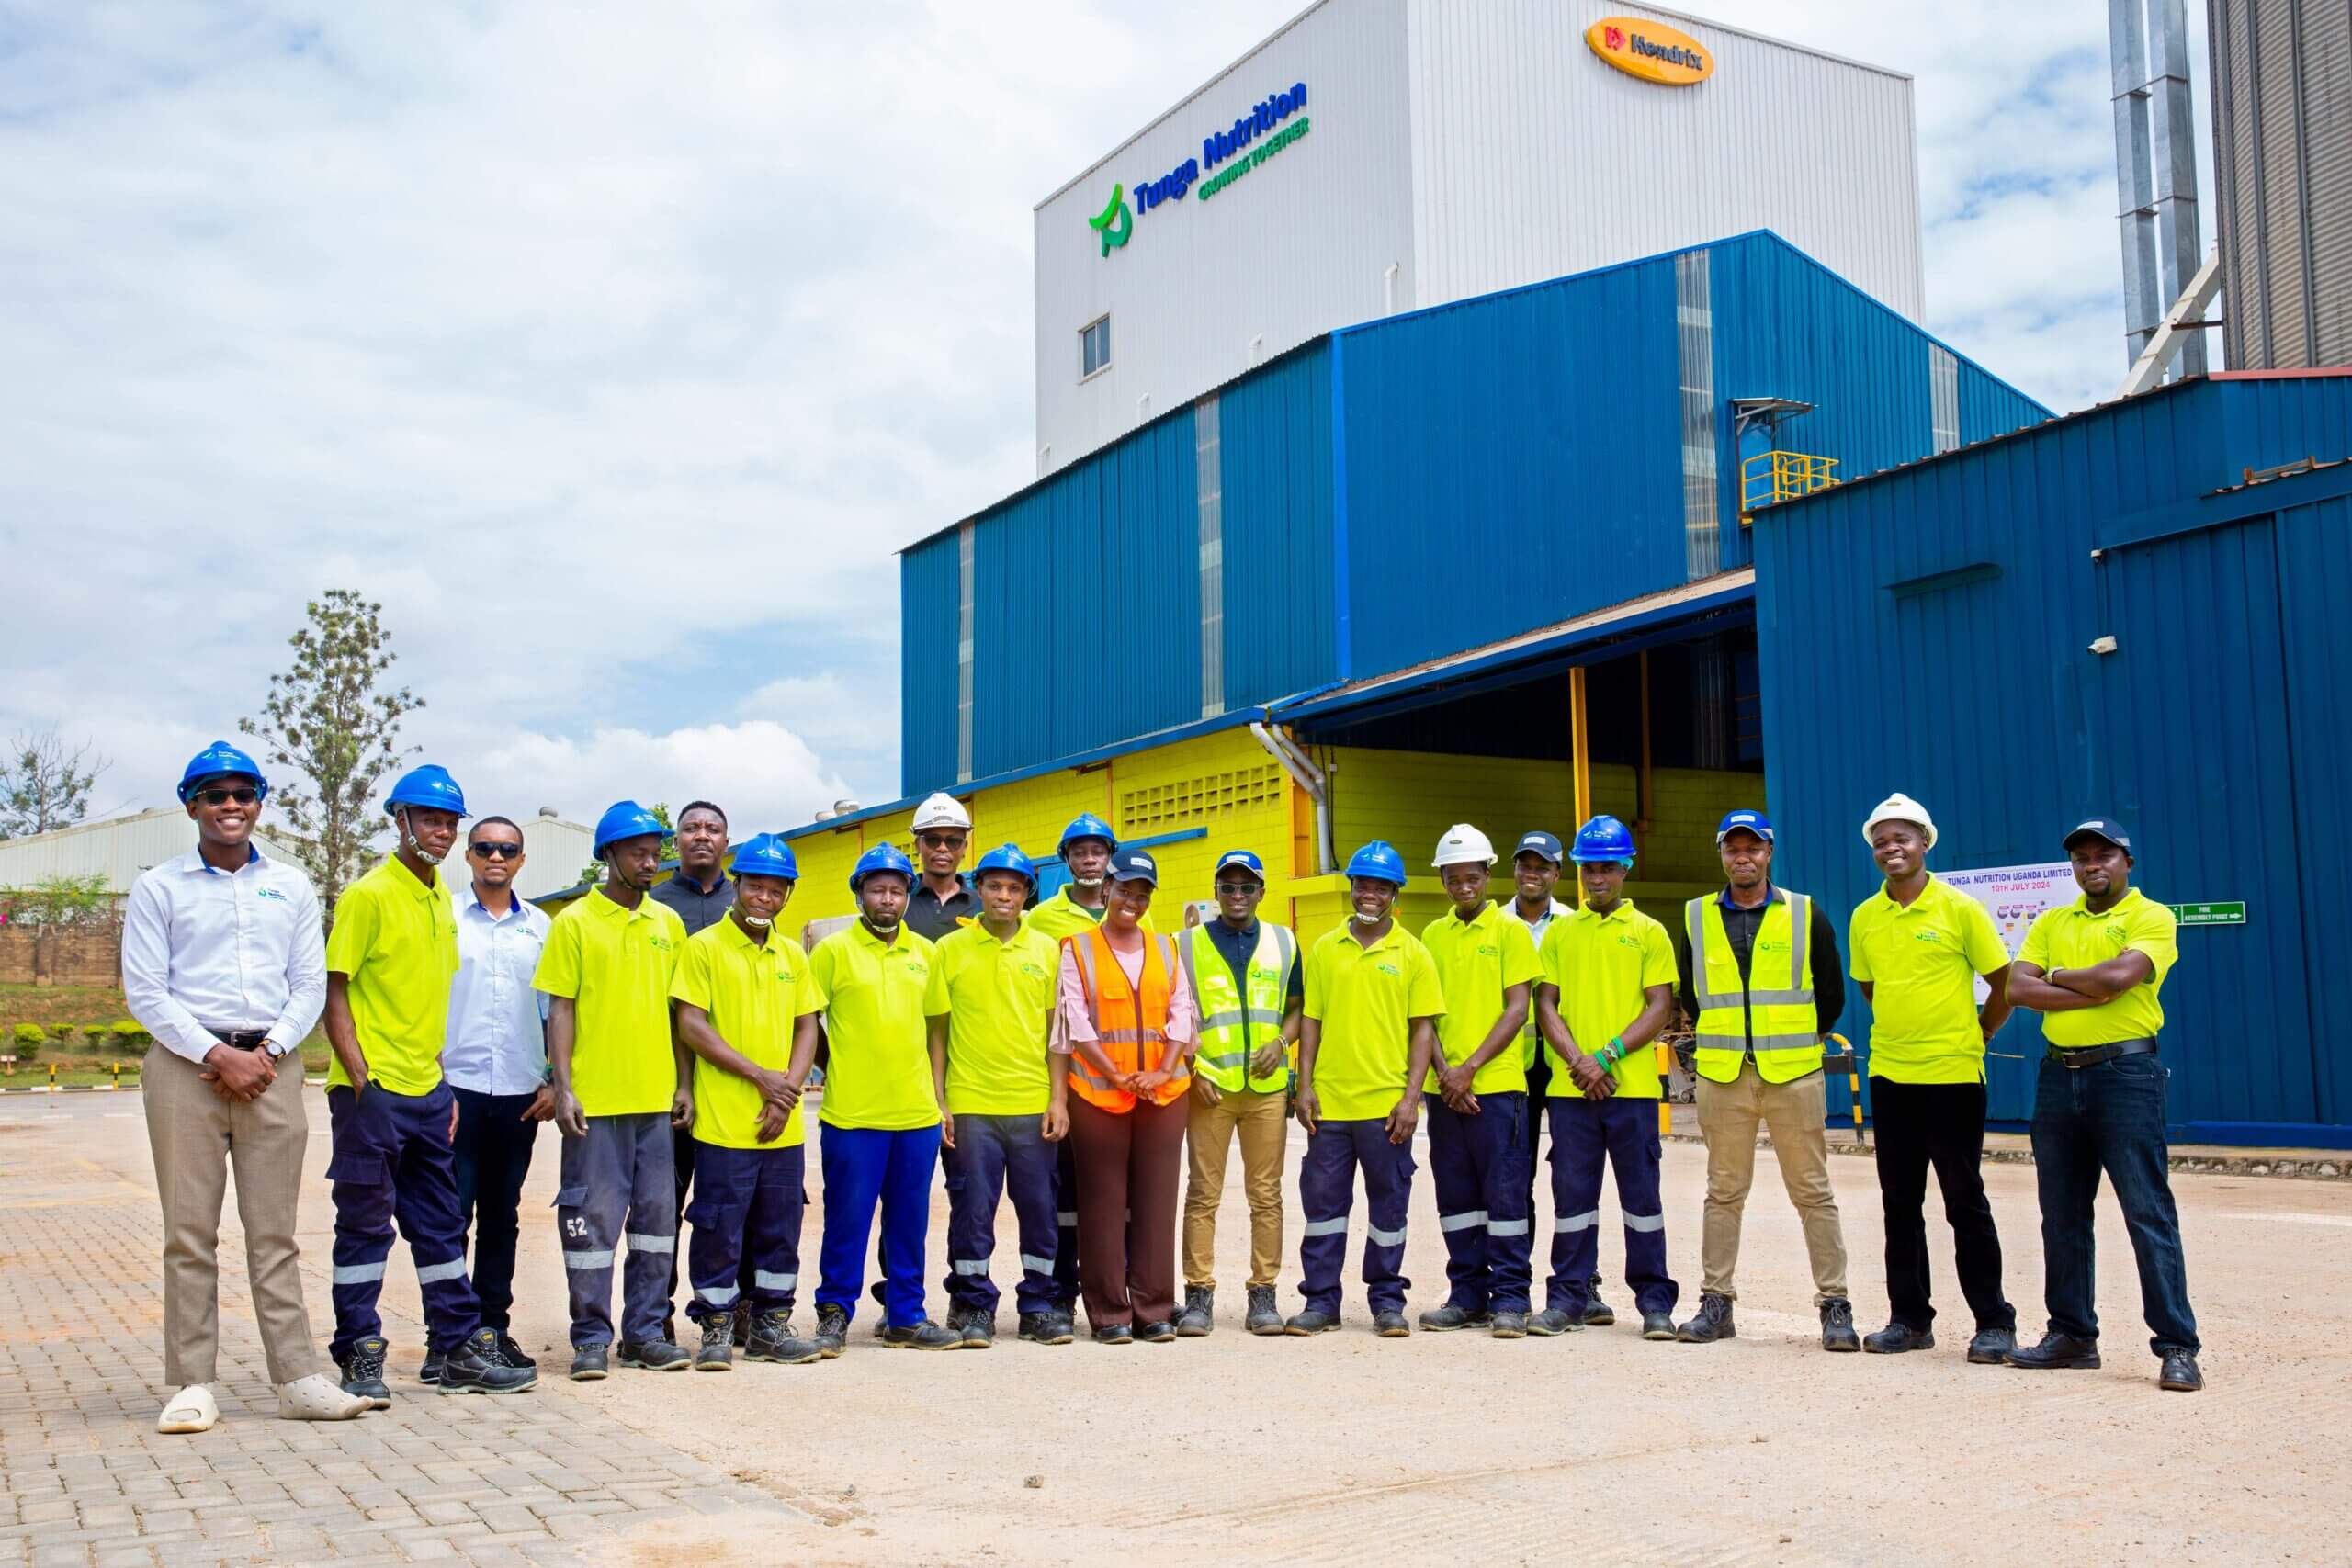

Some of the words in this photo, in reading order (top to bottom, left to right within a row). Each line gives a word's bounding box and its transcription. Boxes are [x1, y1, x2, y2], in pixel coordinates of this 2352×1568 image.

[1631, 33, 1702, 71] Hendrix
[1133, 157, 1199, 215] Tunga
[1203, 82, 1307, 170] Nutrition
[1198, 155, 1250, 200] GROWING
[1249, 117, 1309, 166] TOGETHER
[1948, 877, 1970, 886] TUNGA
[1973, 874, 2011, 884] NUTRITION
[2013, 871, 2041, 881] UGANDA
[2043, 869, 2072, 878] LIMITED
[2011, 883, 2029, 891] JULY
[2032, 882, 2050, 890] 2024
[566, 1217, 588, 1237] 52
